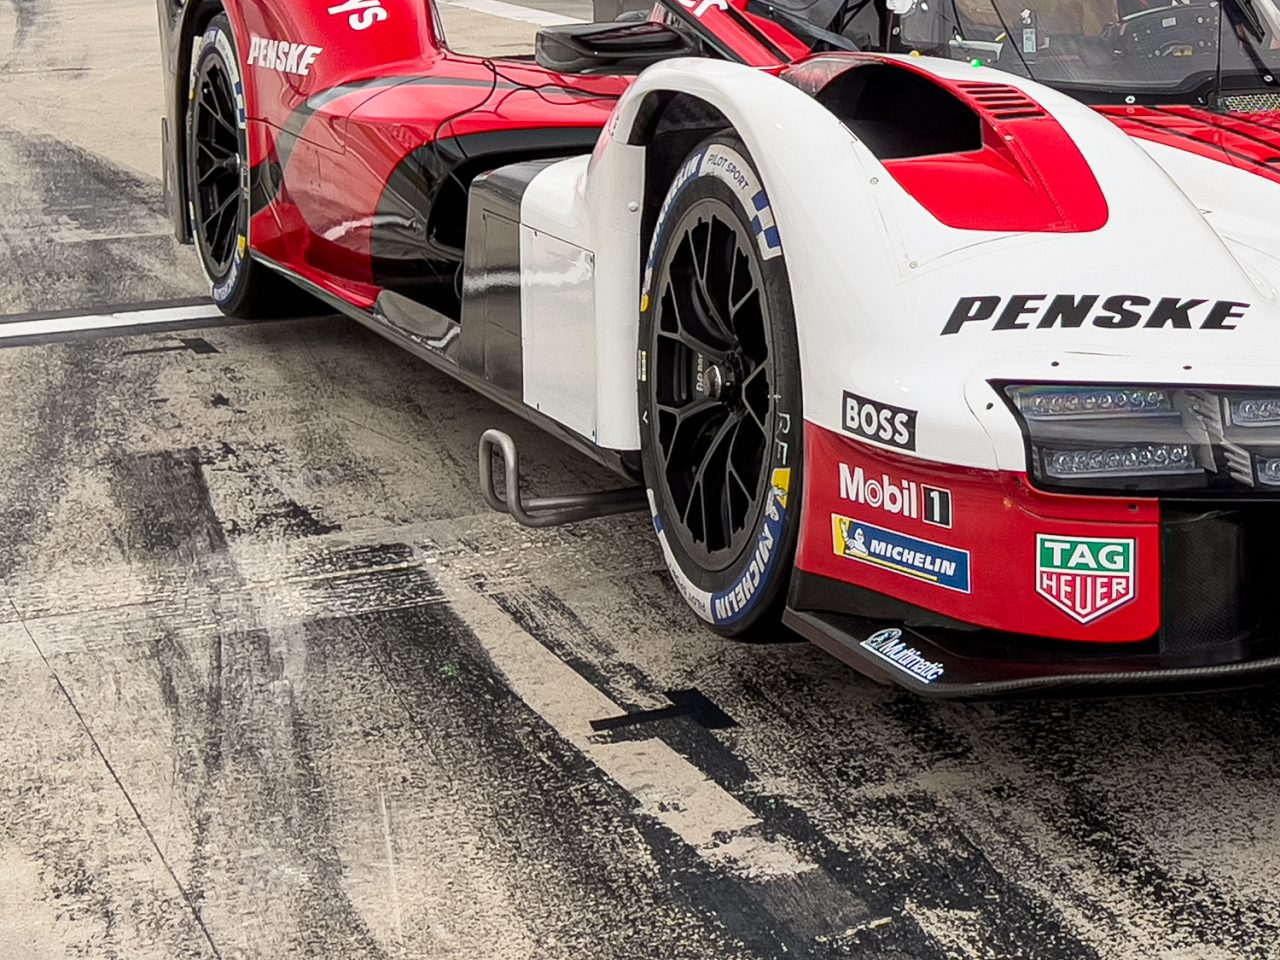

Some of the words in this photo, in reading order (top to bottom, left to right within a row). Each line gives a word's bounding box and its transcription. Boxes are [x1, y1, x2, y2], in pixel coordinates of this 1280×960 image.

[246, 36, 323, 76] PENSKE
[708, 153, 727, 168] PILOT
[725, 162, 749, 191] SPORT
[940, 293, 1251, 336] PENSKE
[846, 397, 910, 445] BOSS
[839, 462, 919, 519] Mobil
[929, 490, 940, 523] 1
[714, 522, 774, 620] MICHELIN
[870, 539, 956, 577] MICHELIN
[1044, 541, 1124, 570] TAG
[1042, 572, 1128, 616] HEUER
[879, 639, 944, 680] Multimatic
